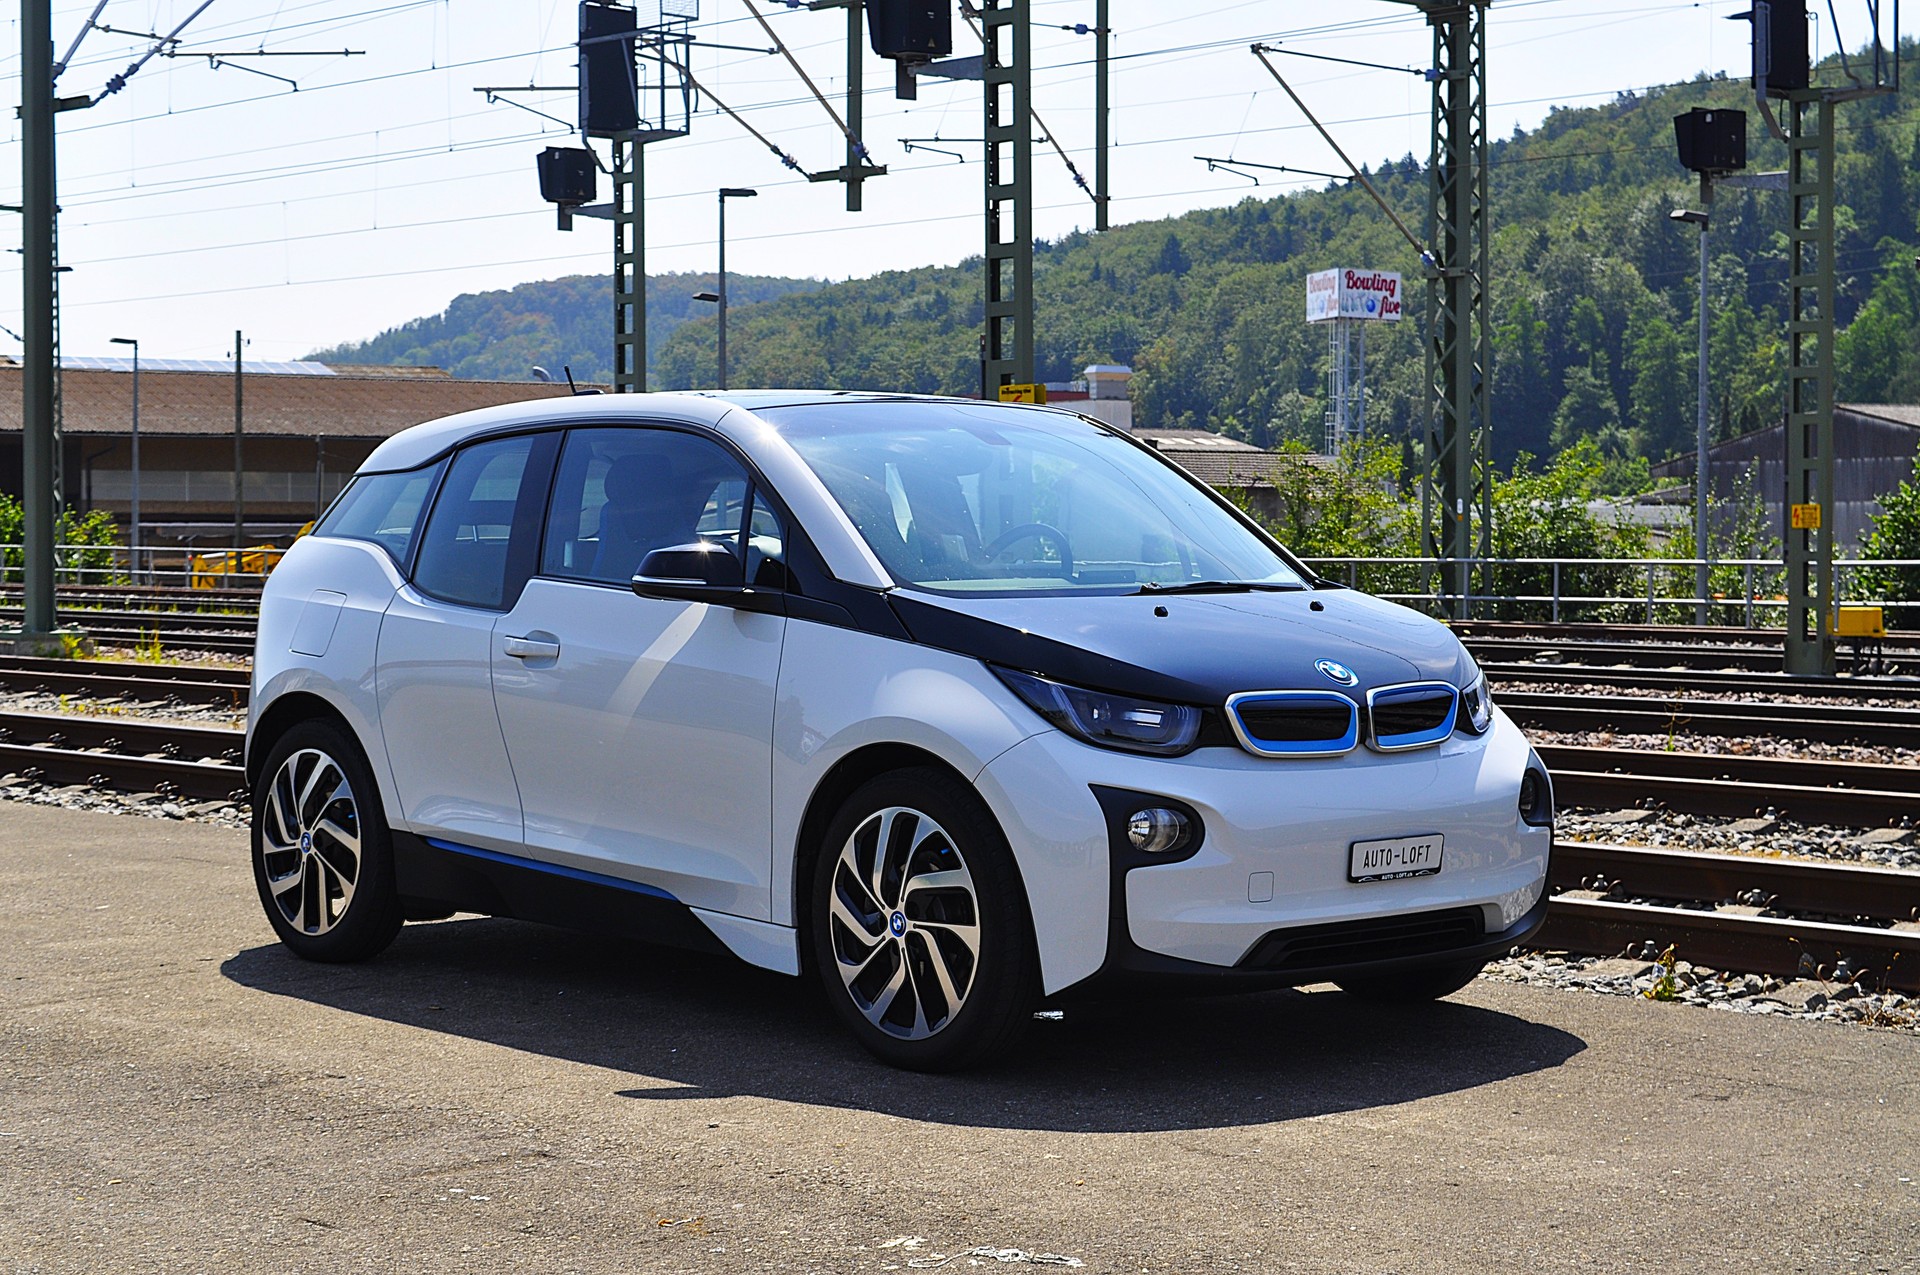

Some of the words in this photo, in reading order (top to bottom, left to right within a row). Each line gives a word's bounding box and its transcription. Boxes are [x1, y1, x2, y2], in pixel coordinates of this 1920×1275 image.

[1345, 270, 1397, 298] Bowling
[1378, 295, 1400, 318] five
[1363, 844, 1431, 868] AUTO-LOFT
